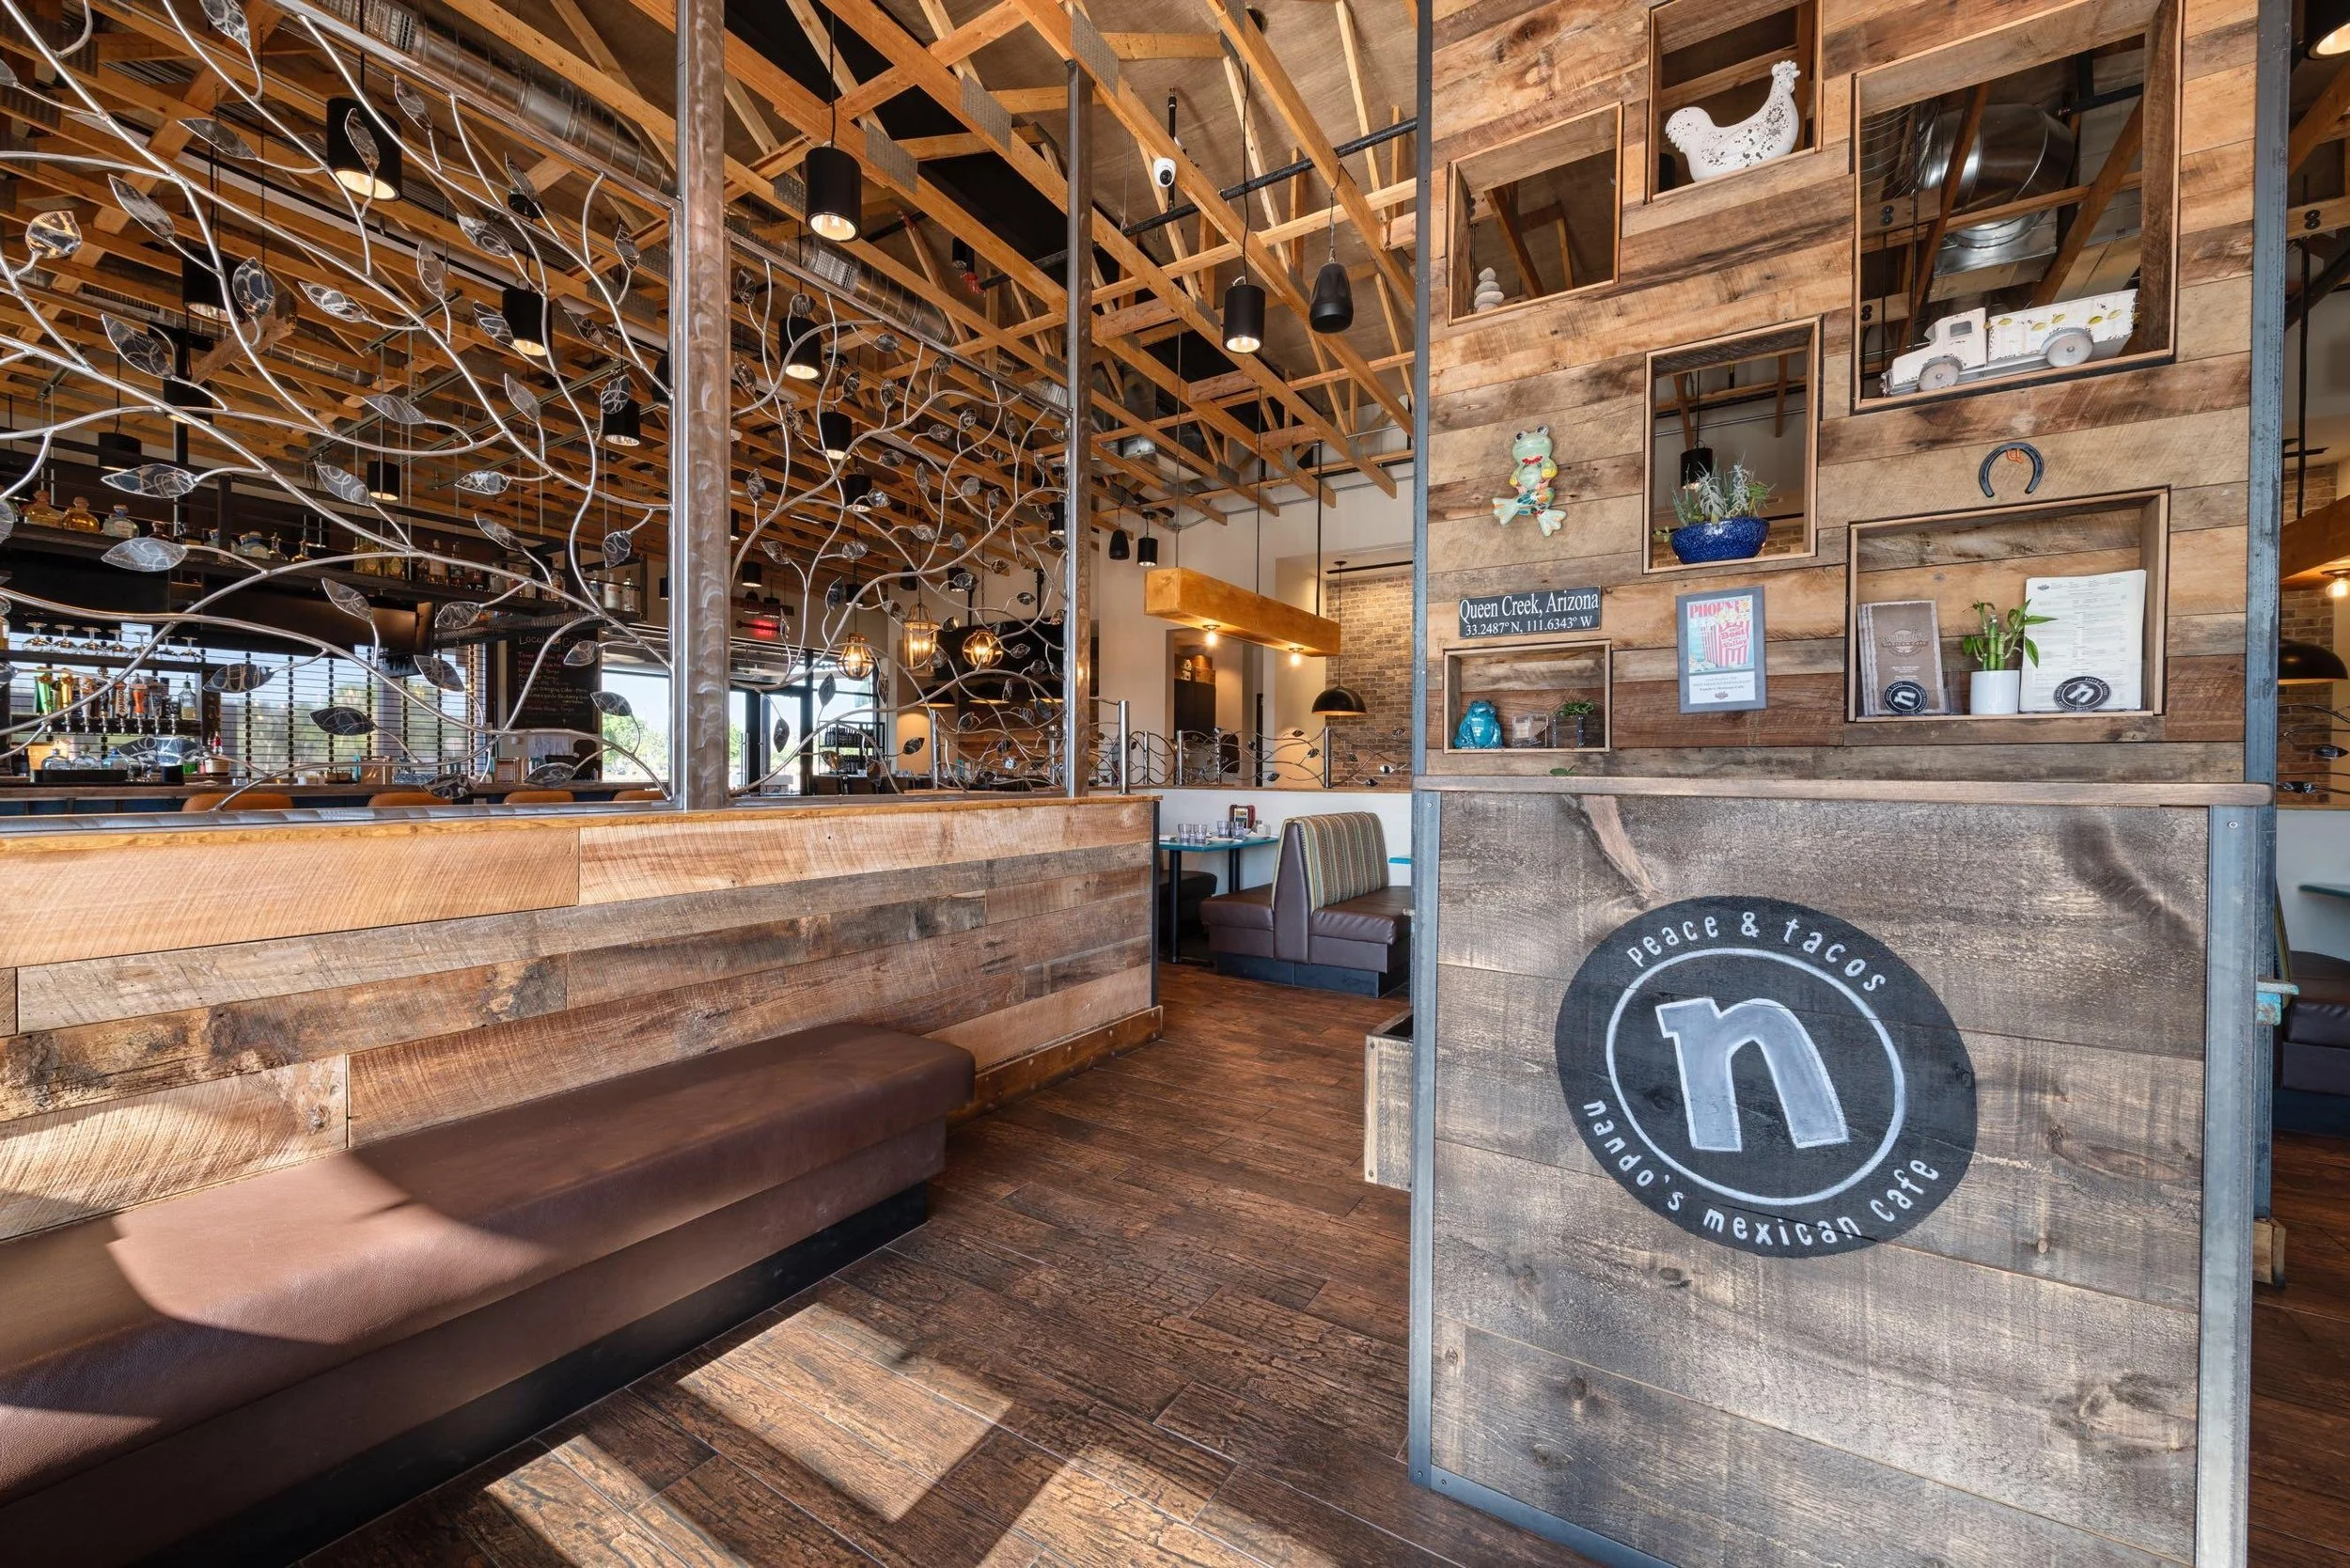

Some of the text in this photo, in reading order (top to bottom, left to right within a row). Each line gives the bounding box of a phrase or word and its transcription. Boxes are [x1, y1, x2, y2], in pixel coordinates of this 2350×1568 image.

[1459, 589, 1599, 624] Queen Creek, Arizona
[1580, 615, 1593, 628] W
[1626, 911, 1887, 993] peace & tacos
[1654, 996, 1850, 1152] n
[1583, 1100, 1684, 1212] nando's
[1702, 1207, 1863, 1247] mexican
